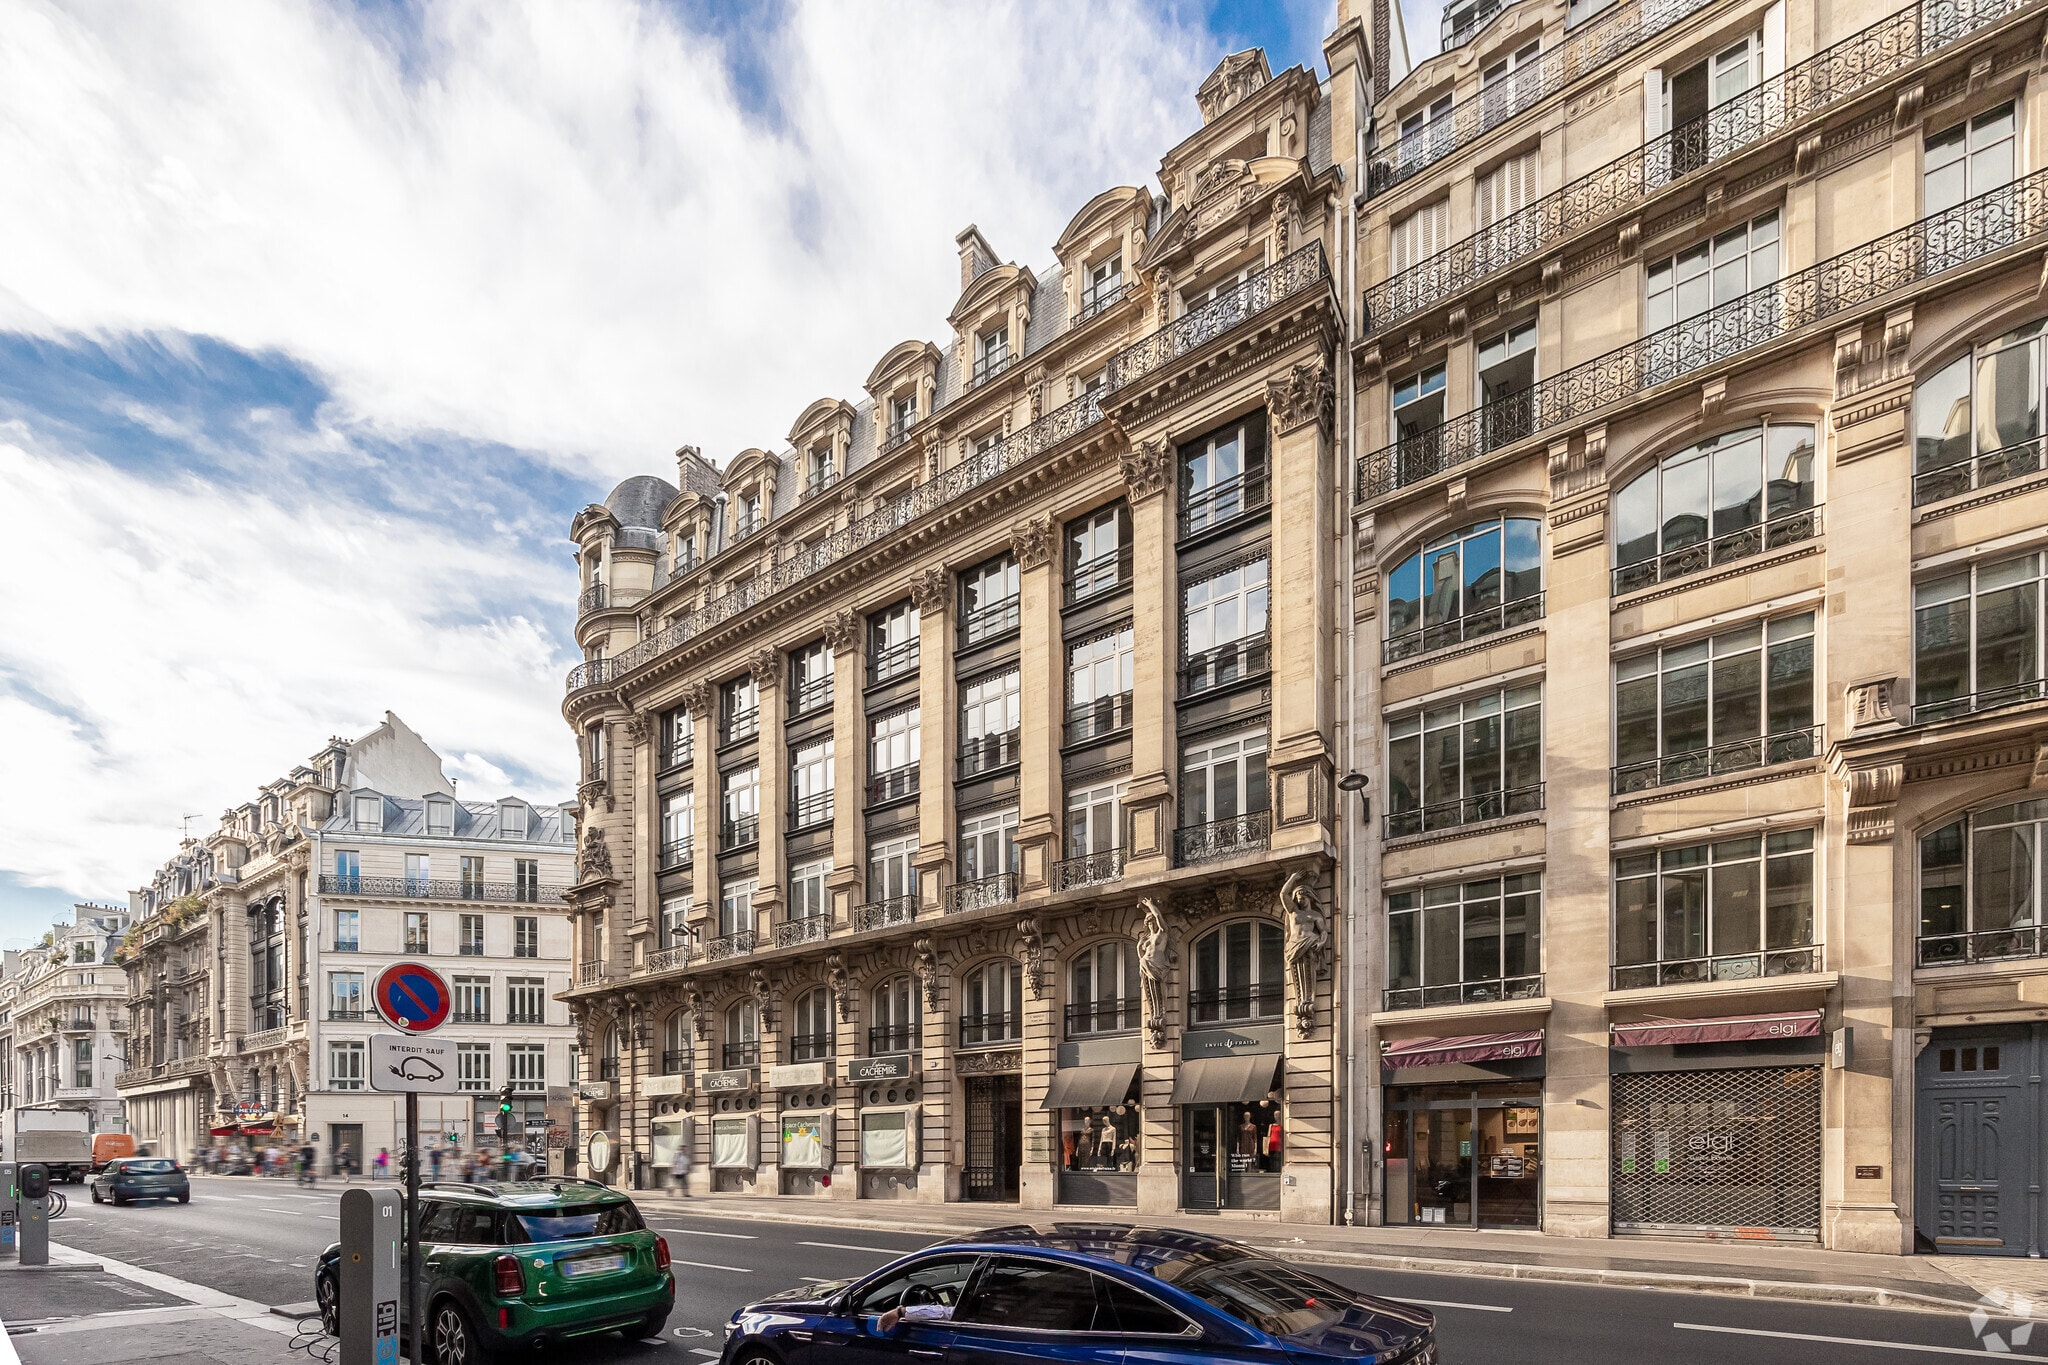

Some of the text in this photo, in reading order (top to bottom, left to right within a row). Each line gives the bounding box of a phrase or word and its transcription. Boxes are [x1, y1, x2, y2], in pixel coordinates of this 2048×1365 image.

[1769, 1022, 1797, 1037] elgi
[389, 1045, 422, 1053] INTERDIT
[1503, 1043, 1525, 1057] elgi
[859, 1066, 897, 1077] CACHEMIRE
[710, 1079, 739, 1088] CACHEMIRE
[382, 1205, 393, 1218] 01
